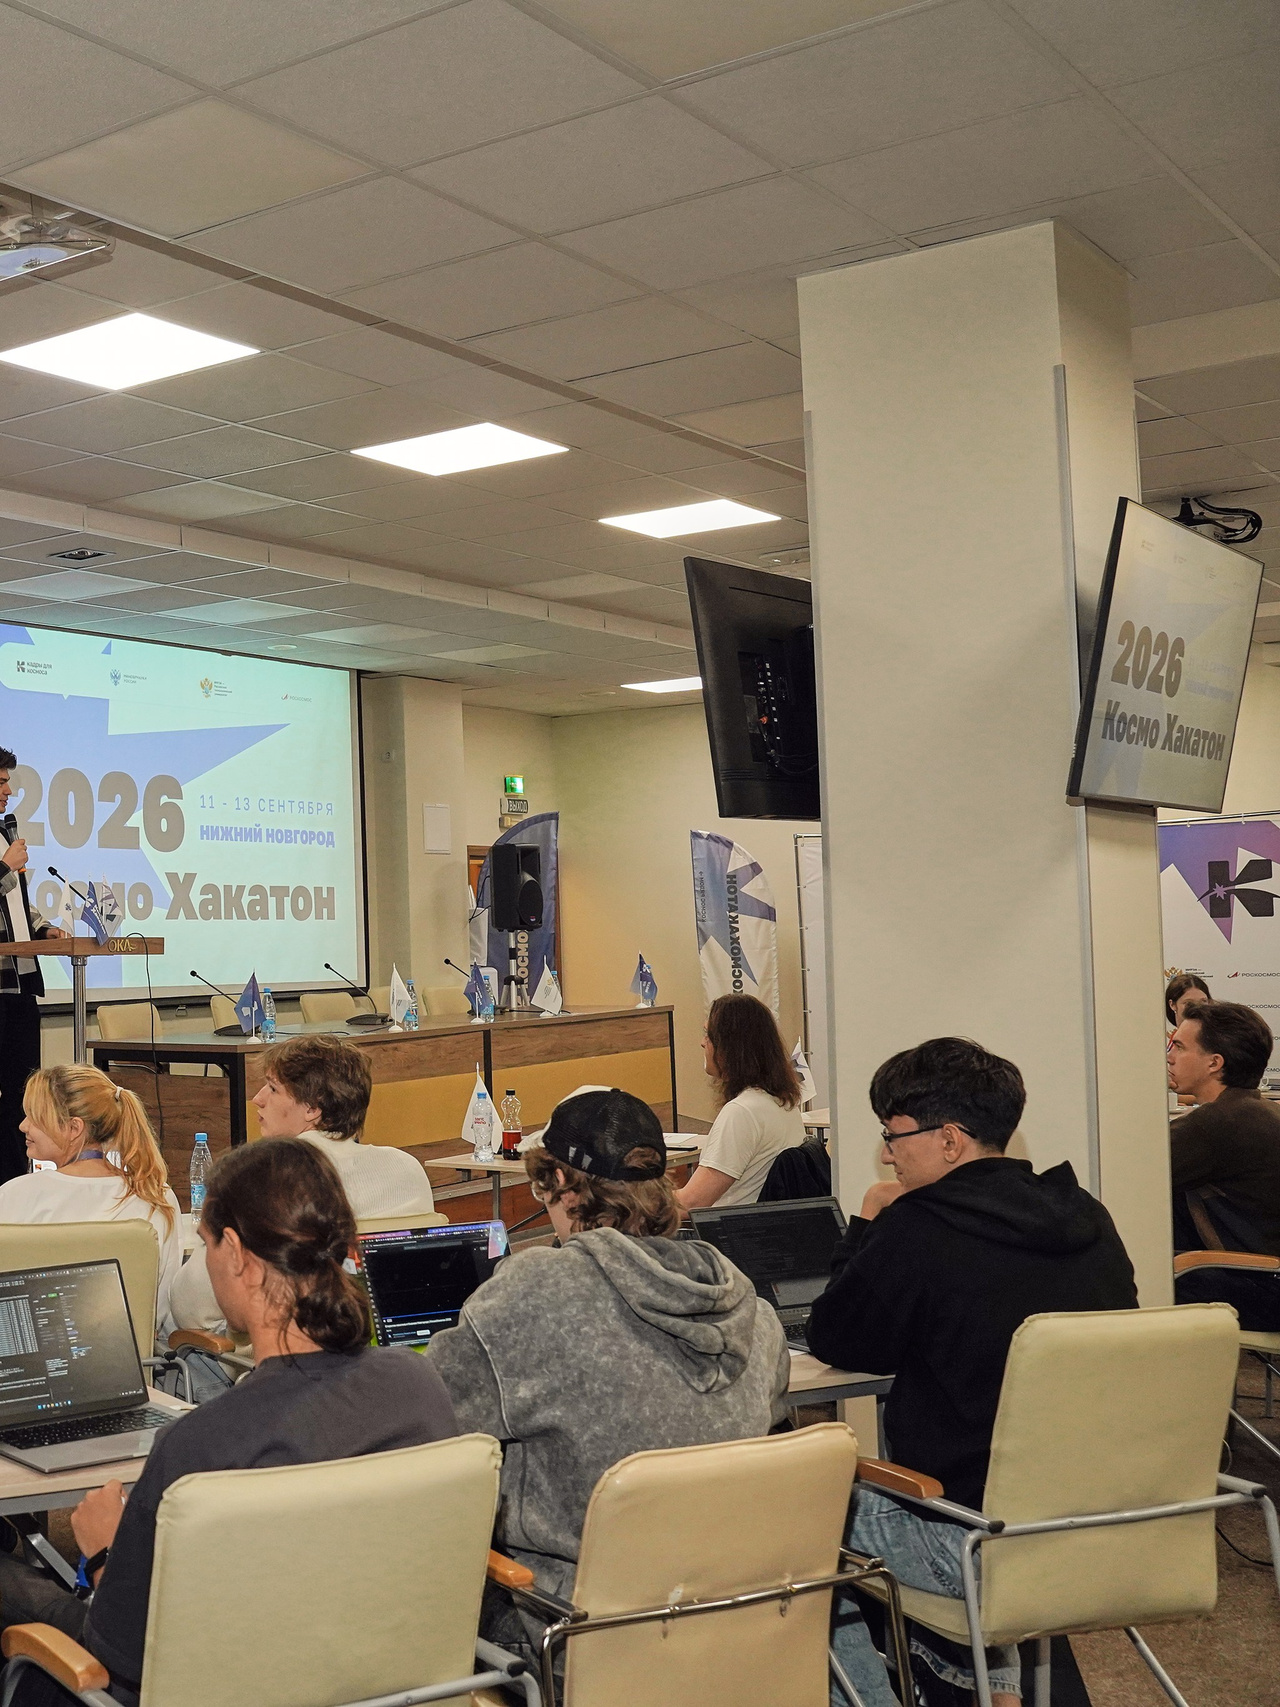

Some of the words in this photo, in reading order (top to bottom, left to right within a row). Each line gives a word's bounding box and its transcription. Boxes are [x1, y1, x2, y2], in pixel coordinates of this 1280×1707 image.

[1111, 620, 1185, 698] 2026
[1101, 699, 1160, 749] Космо
[1160, 712, 1226, 761] Хакатон
[9, 764, 186, 853] 2026
[200, 794, 215, 809] 11
[234, 796, 251, 811] 13
[258, 798, 333, 816] СЕНТЯБРЯ
[199, 823, 263, 843] НИЖНИЙ
[265, 827, 336, 848] НОВГОРОД
[164, 871, 336, 922] Хакатон
